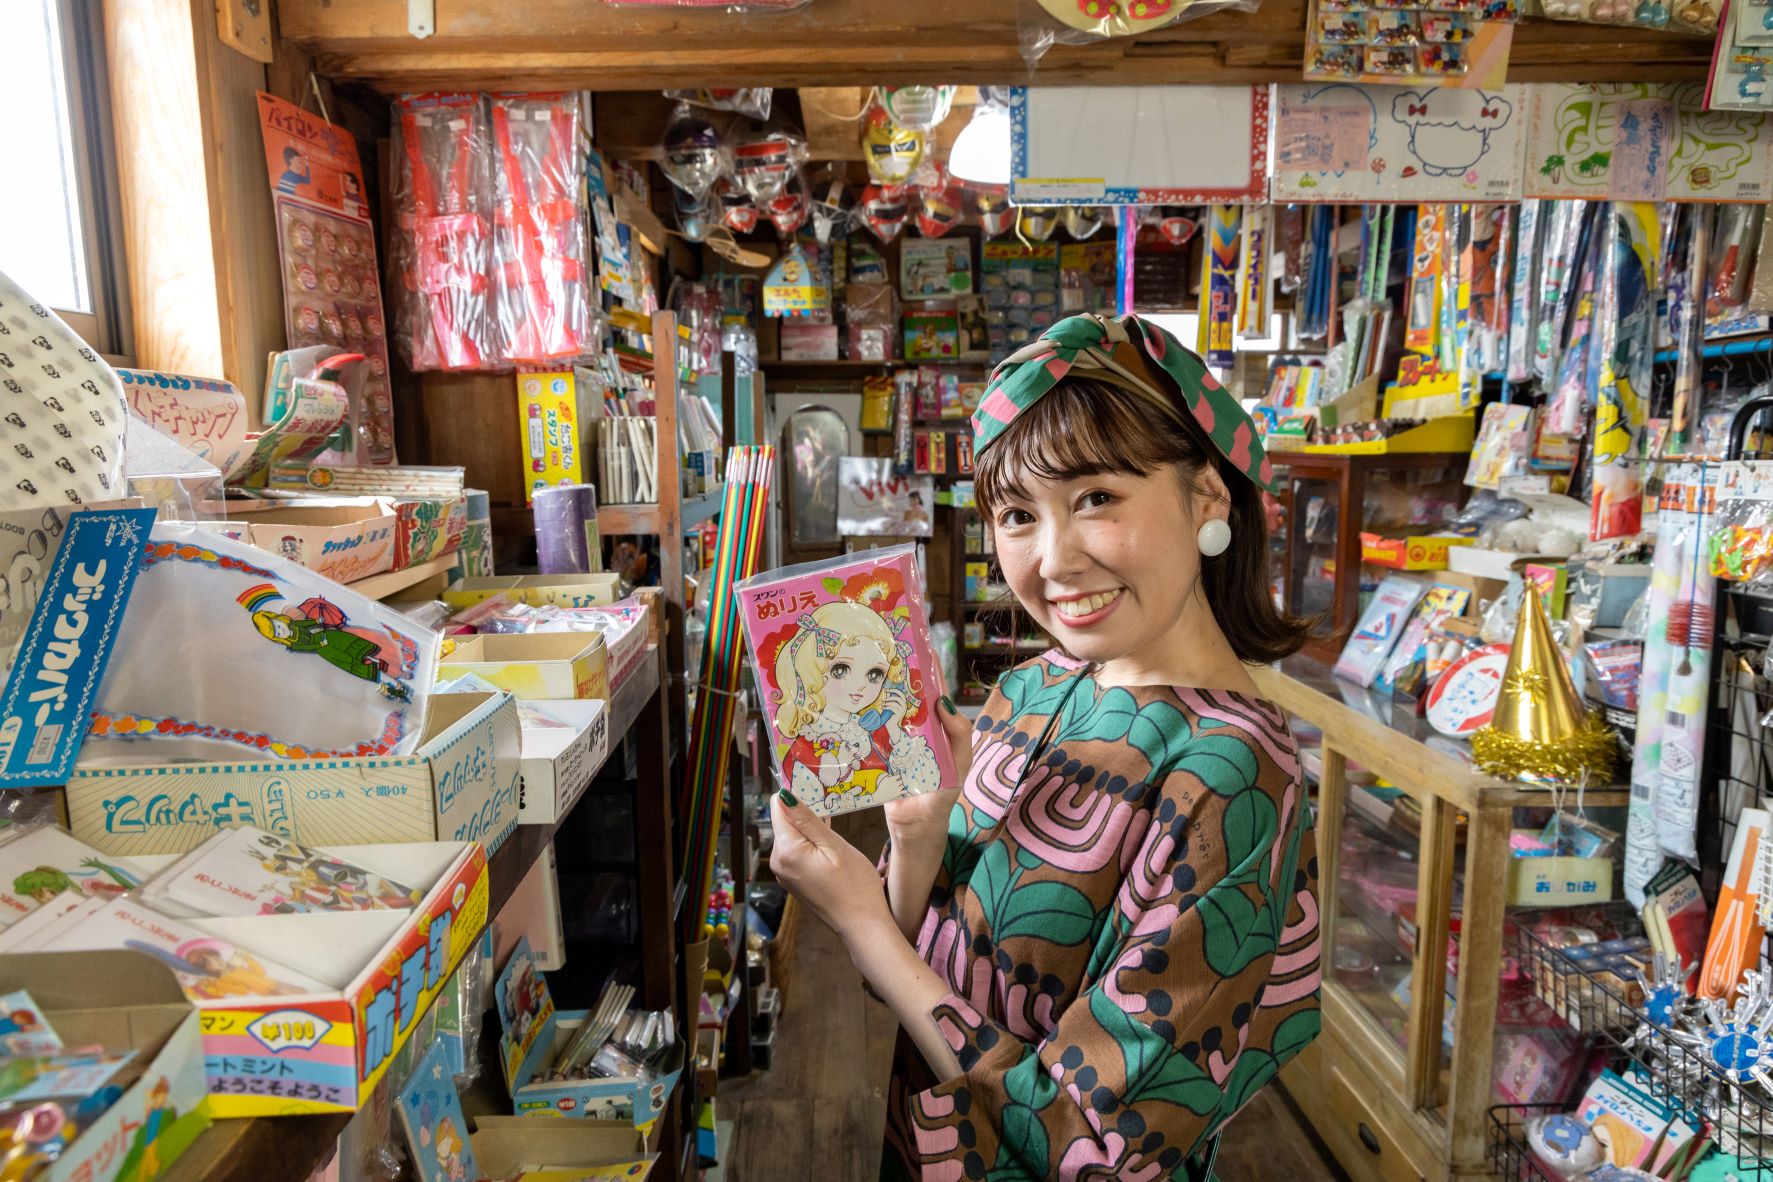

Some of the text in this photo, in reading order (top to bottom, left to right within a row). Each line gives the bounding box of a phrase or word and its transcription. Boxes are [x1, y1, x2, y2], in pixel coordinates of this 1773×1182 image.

[753, 588, 787, 602] スワンの
[756, 590, 821, 622] ぬりえ
[28, 558, 108, 729] ブックカバー
[102, 793, 256, 834] キャップ
[261, 1021, 316, 1041] ¥100
[211, 1077, 342, 1103] ようこそようこ
